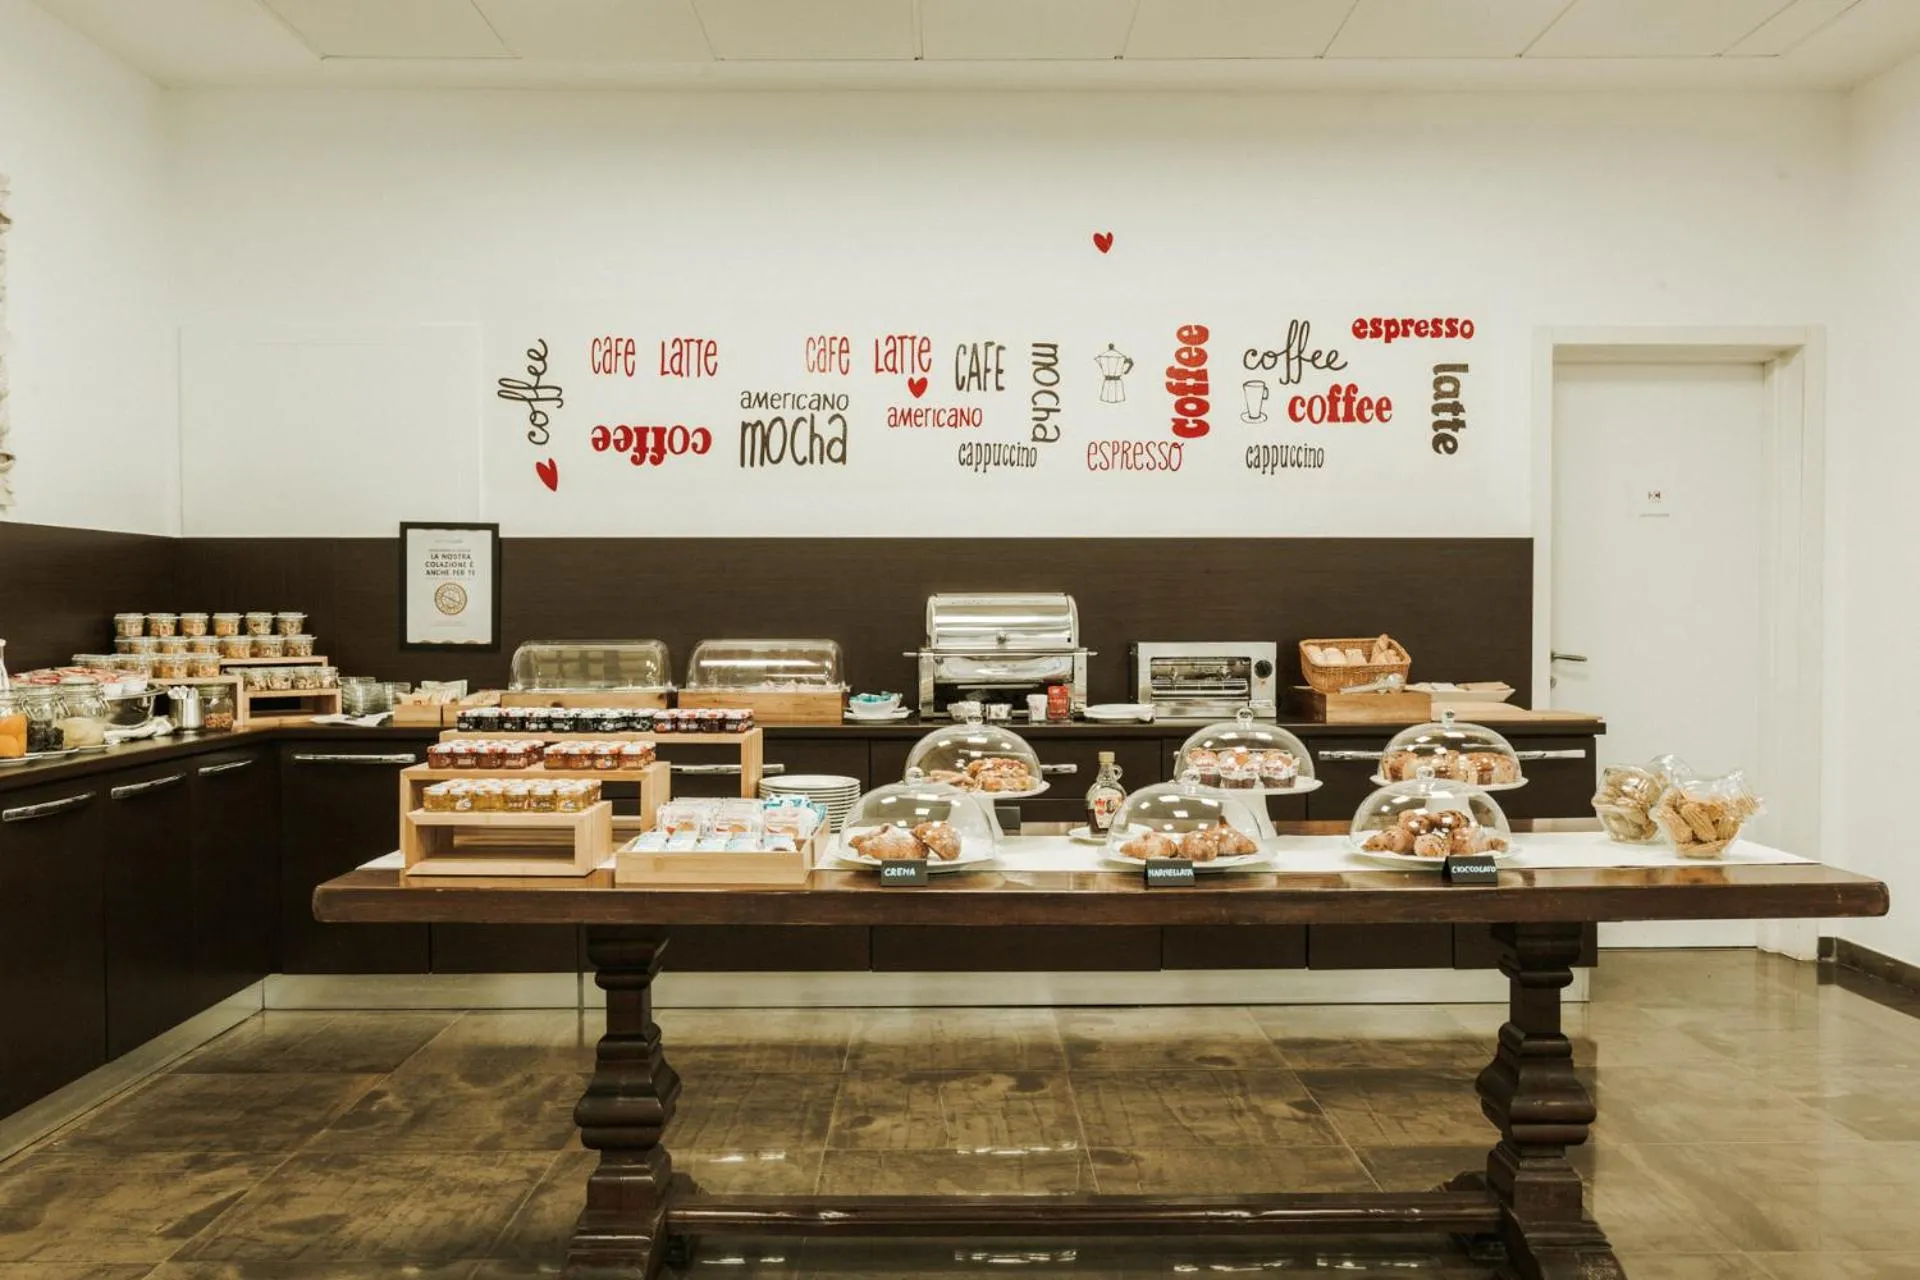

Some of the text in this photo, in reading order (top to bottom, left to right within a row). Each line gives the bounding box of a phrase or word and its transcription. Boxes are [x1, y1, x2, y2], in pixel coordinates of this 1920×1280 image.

[1243, 319, 1348, 385] coffee
[1352, 317, 1475, 343] espresso
[497, 338, 564, 446] coffee
[955, 341, 1006, 392] CAFE
[1165, 324, 1210, 439] coffee
[1031, 342, 1061, 443] mocha
[1286, 383, 1393, 425] coffee
[1431, 363, 1470, 455] latte
[591, 424, 712, 466] coffee
[740, 413, 848, 468] mocha
[957, 442, 1037, 474] cappuccino
[1245, 443, 1325, 475] cappuccino
[884, 867, 916, 877] CREMA
